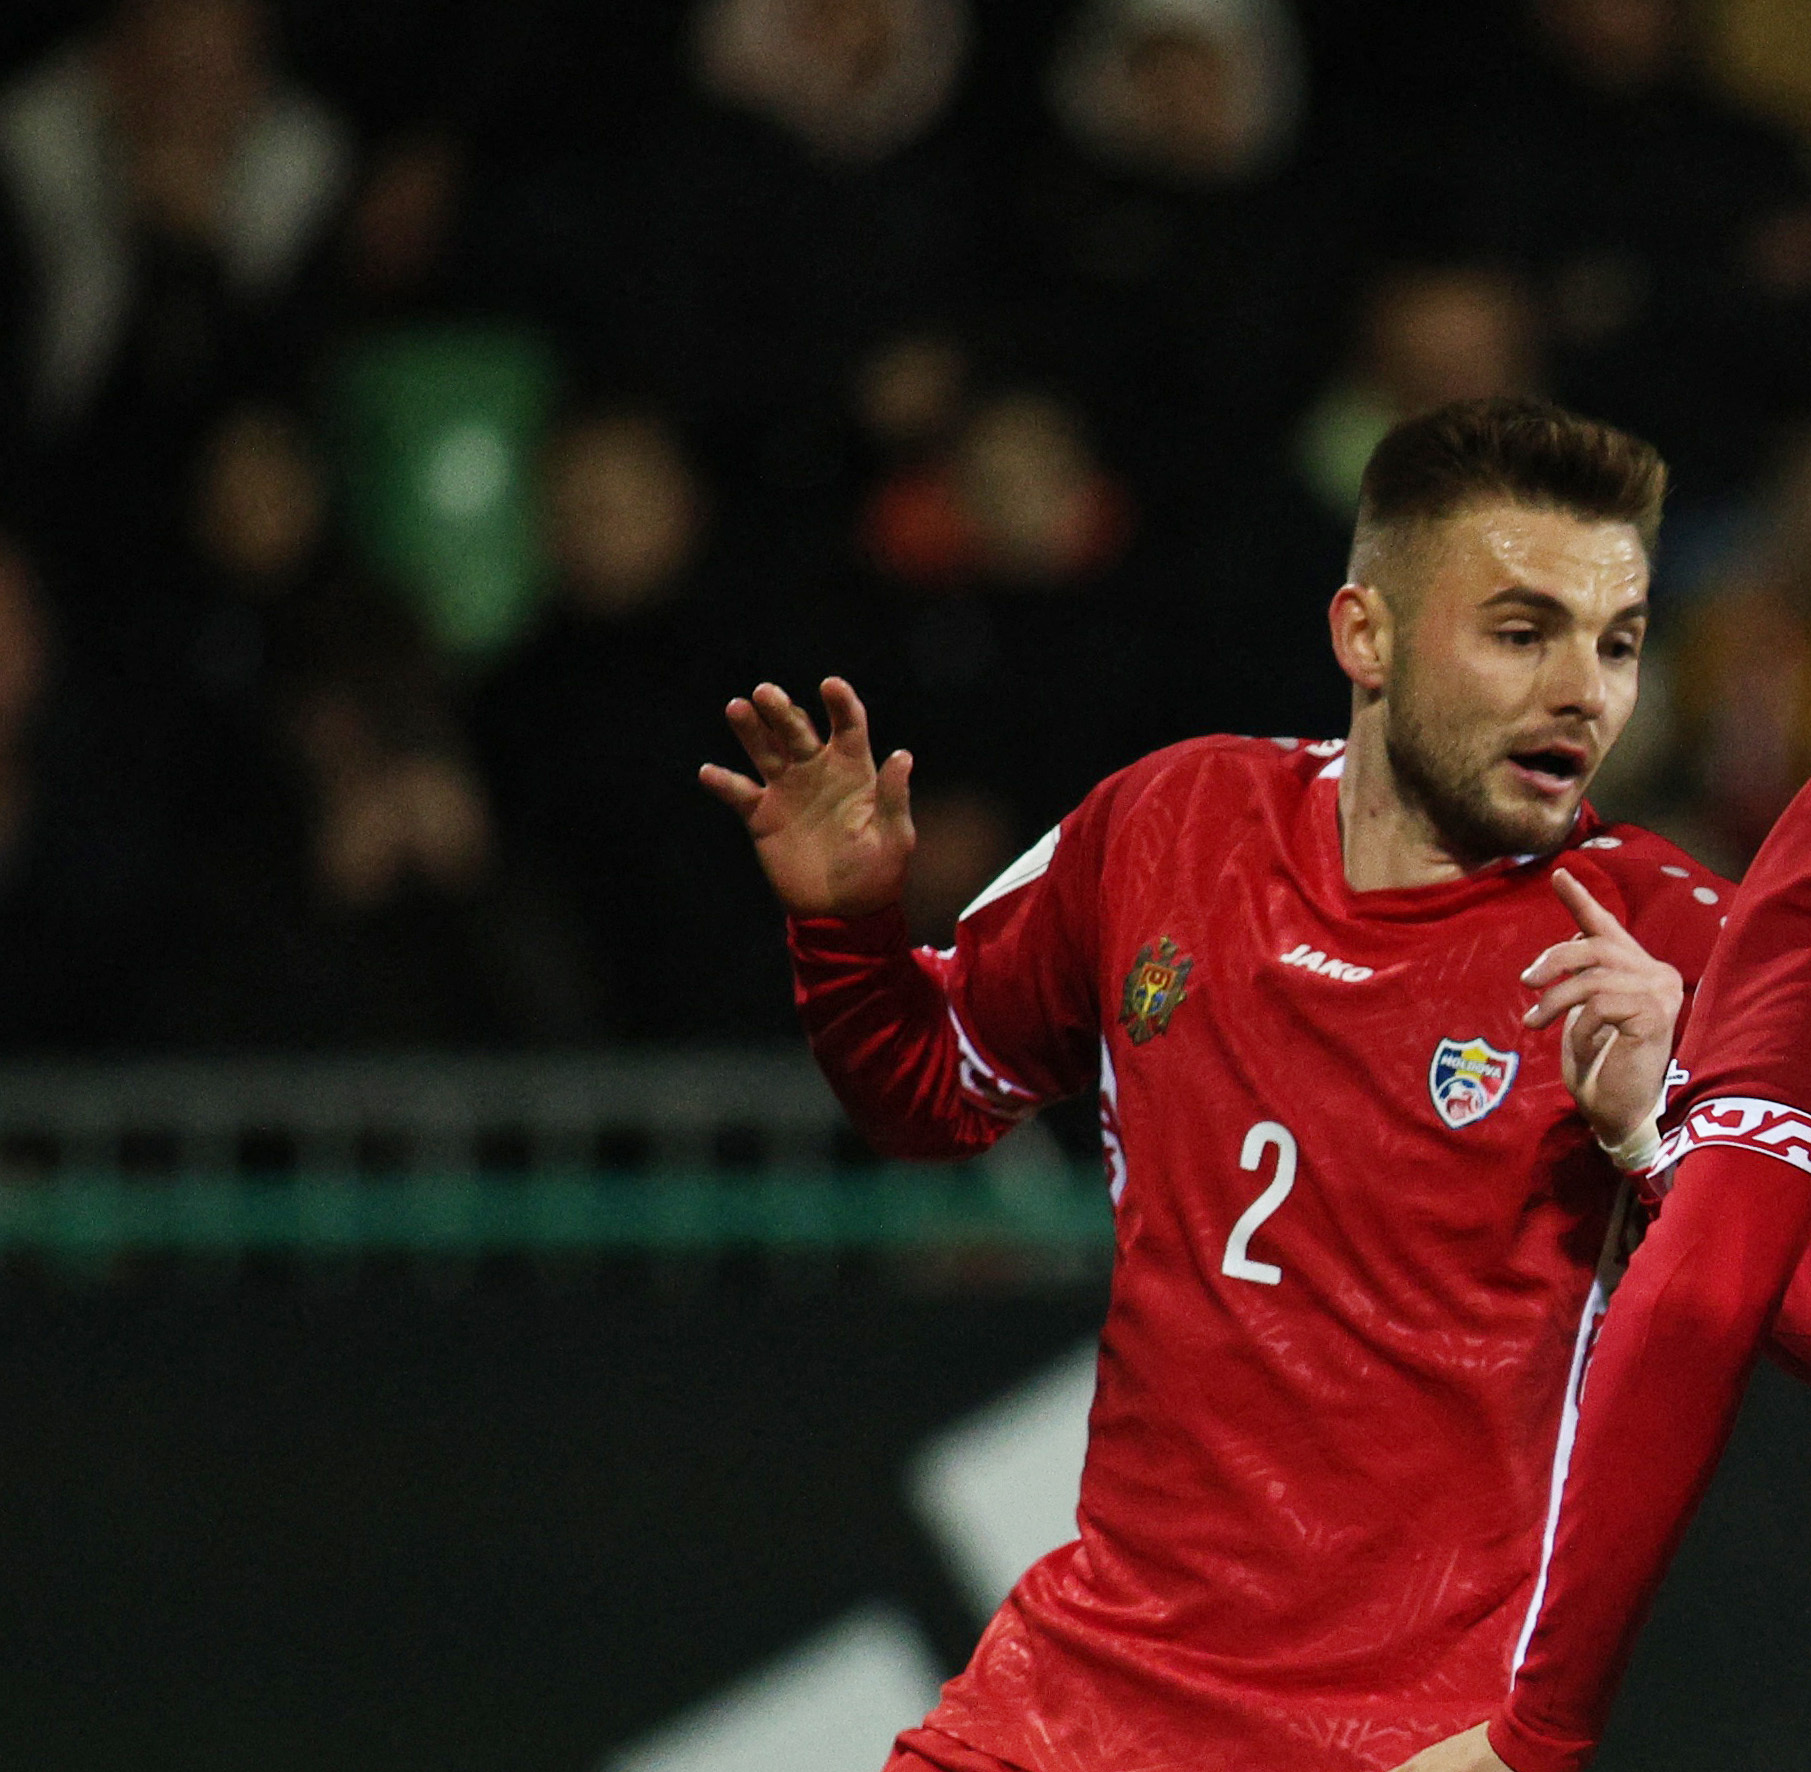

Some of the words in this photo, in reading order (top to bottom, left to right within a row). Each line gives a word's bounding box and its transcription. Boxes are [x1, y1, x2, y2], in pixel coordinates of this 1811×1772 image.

[1279, 943, 1375, 983] JAKO
[1440, 1053, 1502, 1078] MOLDOVA
[1221, 1120, 1298, 1286] 2
